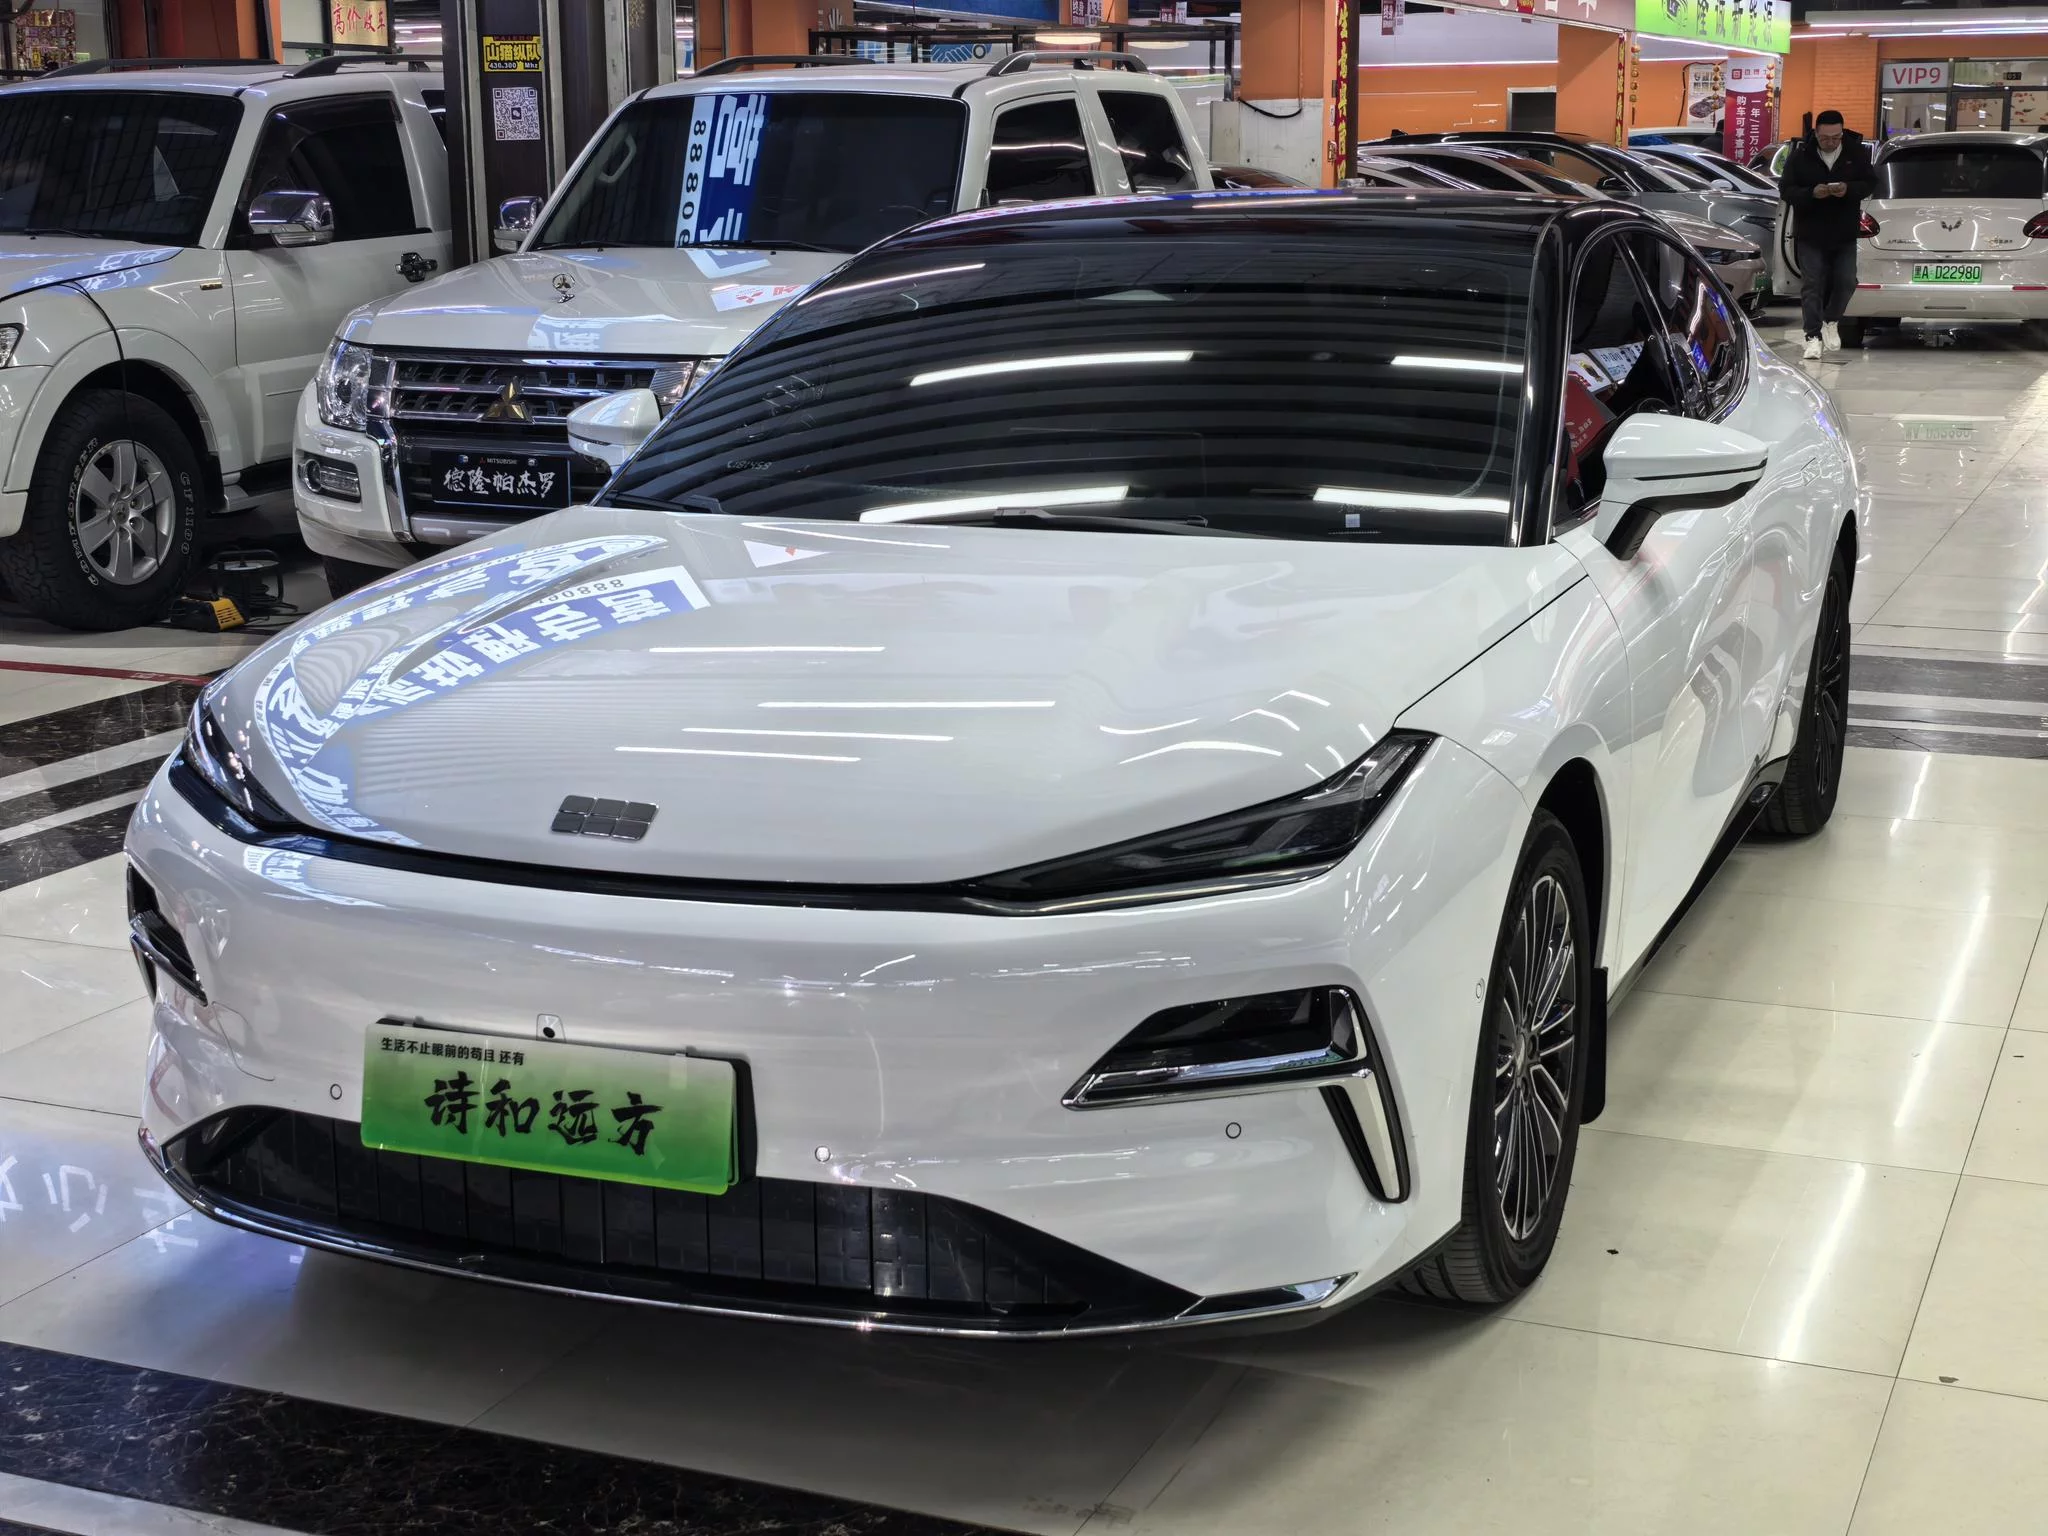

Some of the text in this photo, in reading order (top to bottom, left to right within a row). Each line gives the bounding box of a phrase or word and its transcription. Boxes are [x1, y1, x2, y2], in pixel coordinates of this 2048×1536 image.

[485, 43, 540, 61] 山猫纵队
[1893, 67, 1941, 85] VIP9
[1935, 265, 1981, 280] D22980
[443, 466, 556, 499] 德隆帕杰罗
[380, 1036, 525, 1067] 生活不止眼前的苟且 还有
[424, 1070, 665, 1156] 诗和远方
